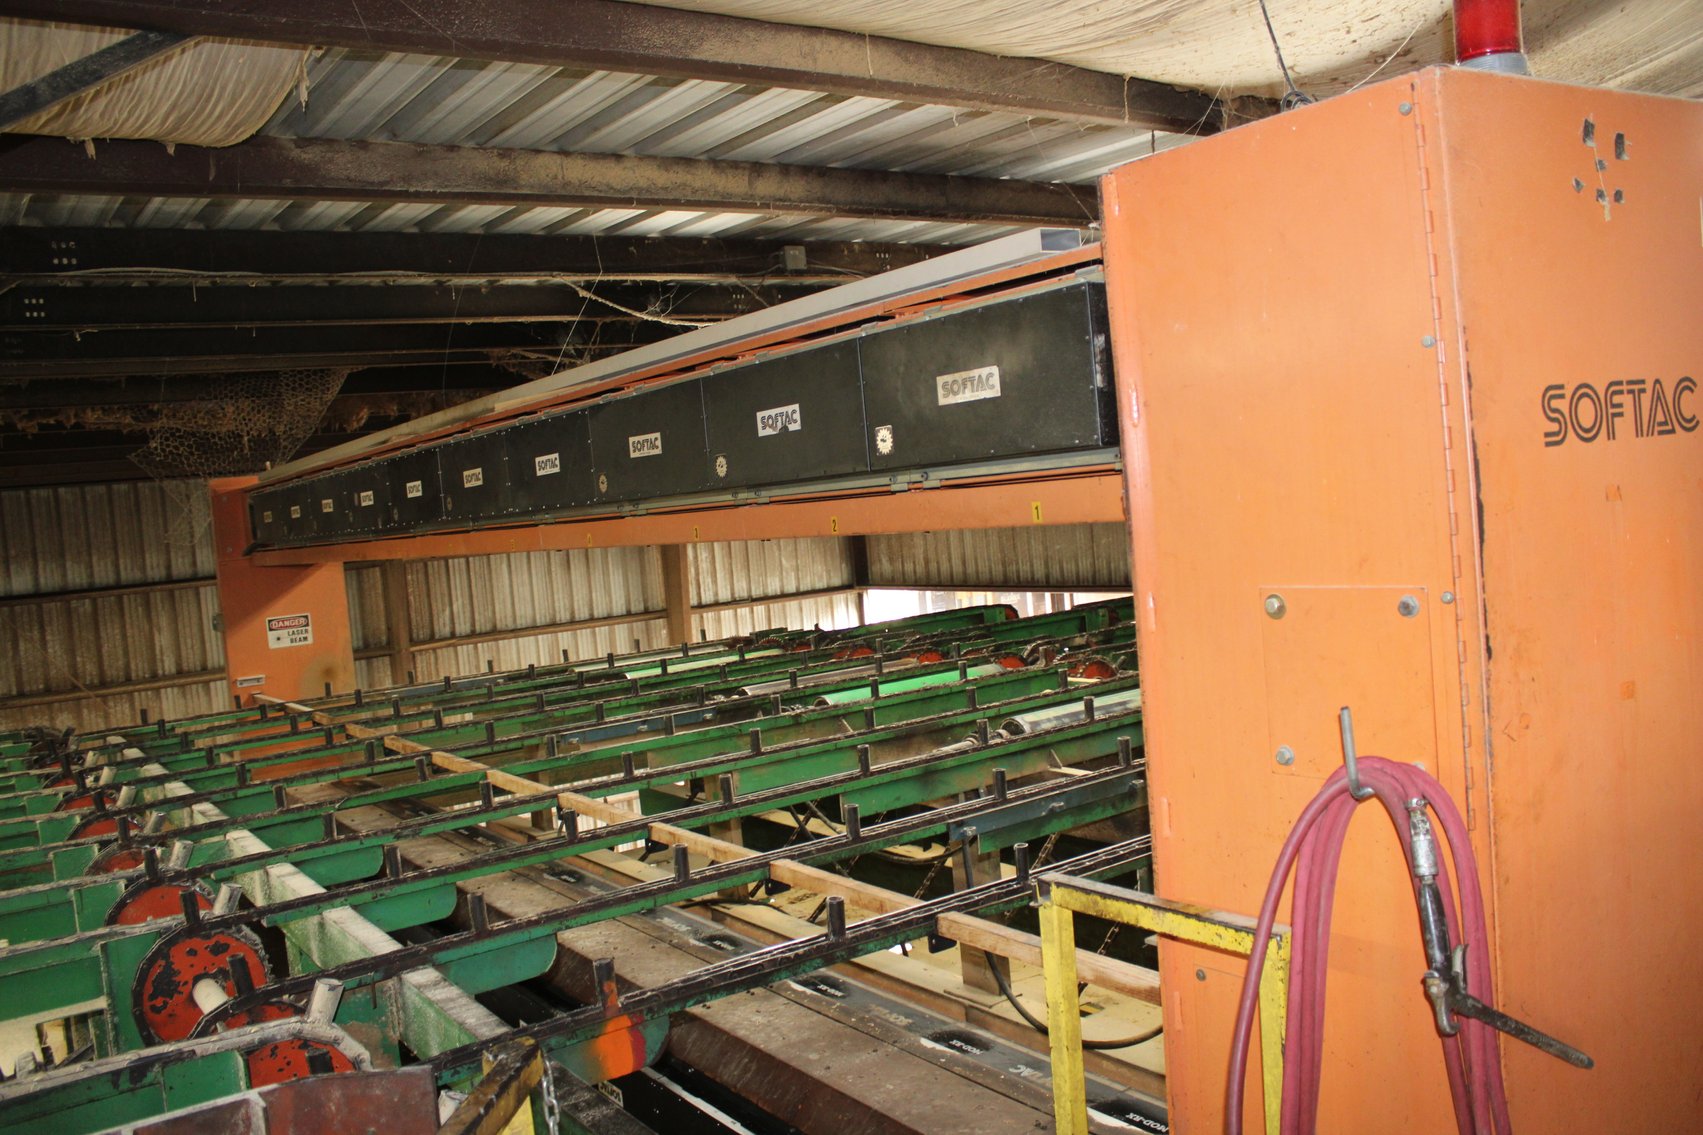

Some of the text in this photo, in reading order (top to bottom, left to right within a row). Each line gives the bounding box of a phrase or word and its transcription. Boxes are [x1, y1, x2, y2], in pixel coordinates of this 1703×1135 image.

[941, 372, 996, 399] SOFTAC
[1541, 376, 1700, 447] SOFTAC
[760, 408, 799, 431] SOFTAC
[631, 437, 660, 453] SOFTAC
[537, 456, 559, 472] SOFTAC
[1034, 505, 1040, 520] 1
[832, 519, 837, 532] 2
[272, 618, 305, 628] DANGER
[287, 628, 309, 637] LASER
[289, 636, 309, 644] BEAM
